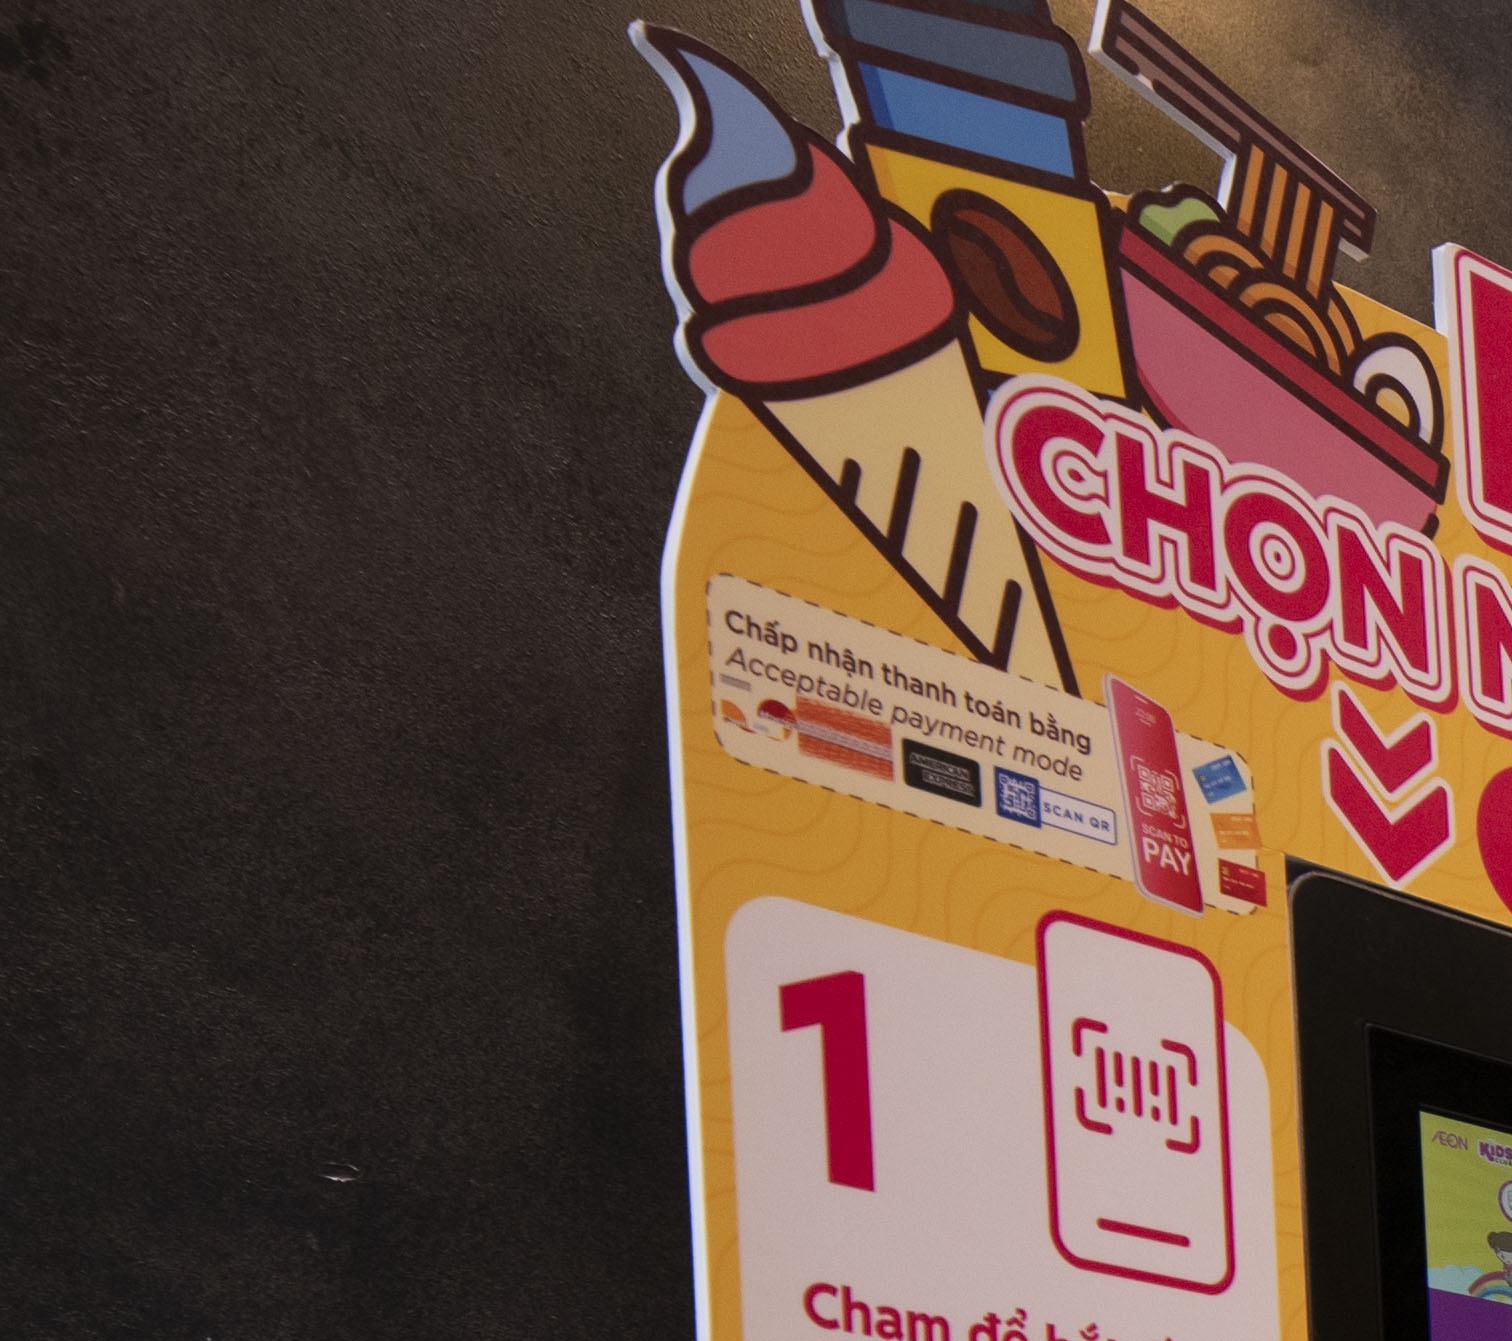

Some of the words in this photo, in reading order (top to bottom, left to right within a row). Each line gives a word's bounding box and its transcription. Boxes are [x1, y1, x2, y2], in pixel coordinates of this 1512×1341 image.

[993, 384, 1446, 686] CHỌN
[725, 610, 798, 653] Chấp
[808, 641, 873, 679] nhận
[882, 665, 956, 707] thanh
[964, 689, 1020, 729] toán
[1030, 712, 1092, 755] bằng
[726, 647, 883, 716] Acceptable
[891, 704, 1004, 757] payment
[1013, 745, 1083, 782] mode
[1043, 802, 1084, 824] SCAN
[1090, 817, 1110, 832] QR
[1142, 823, 1169, 844] SCAN
[1171, 830, 1188, 849] TO
[1142, 837, 1191, 875] PAY
[778, 970, 875, 1192] 1
